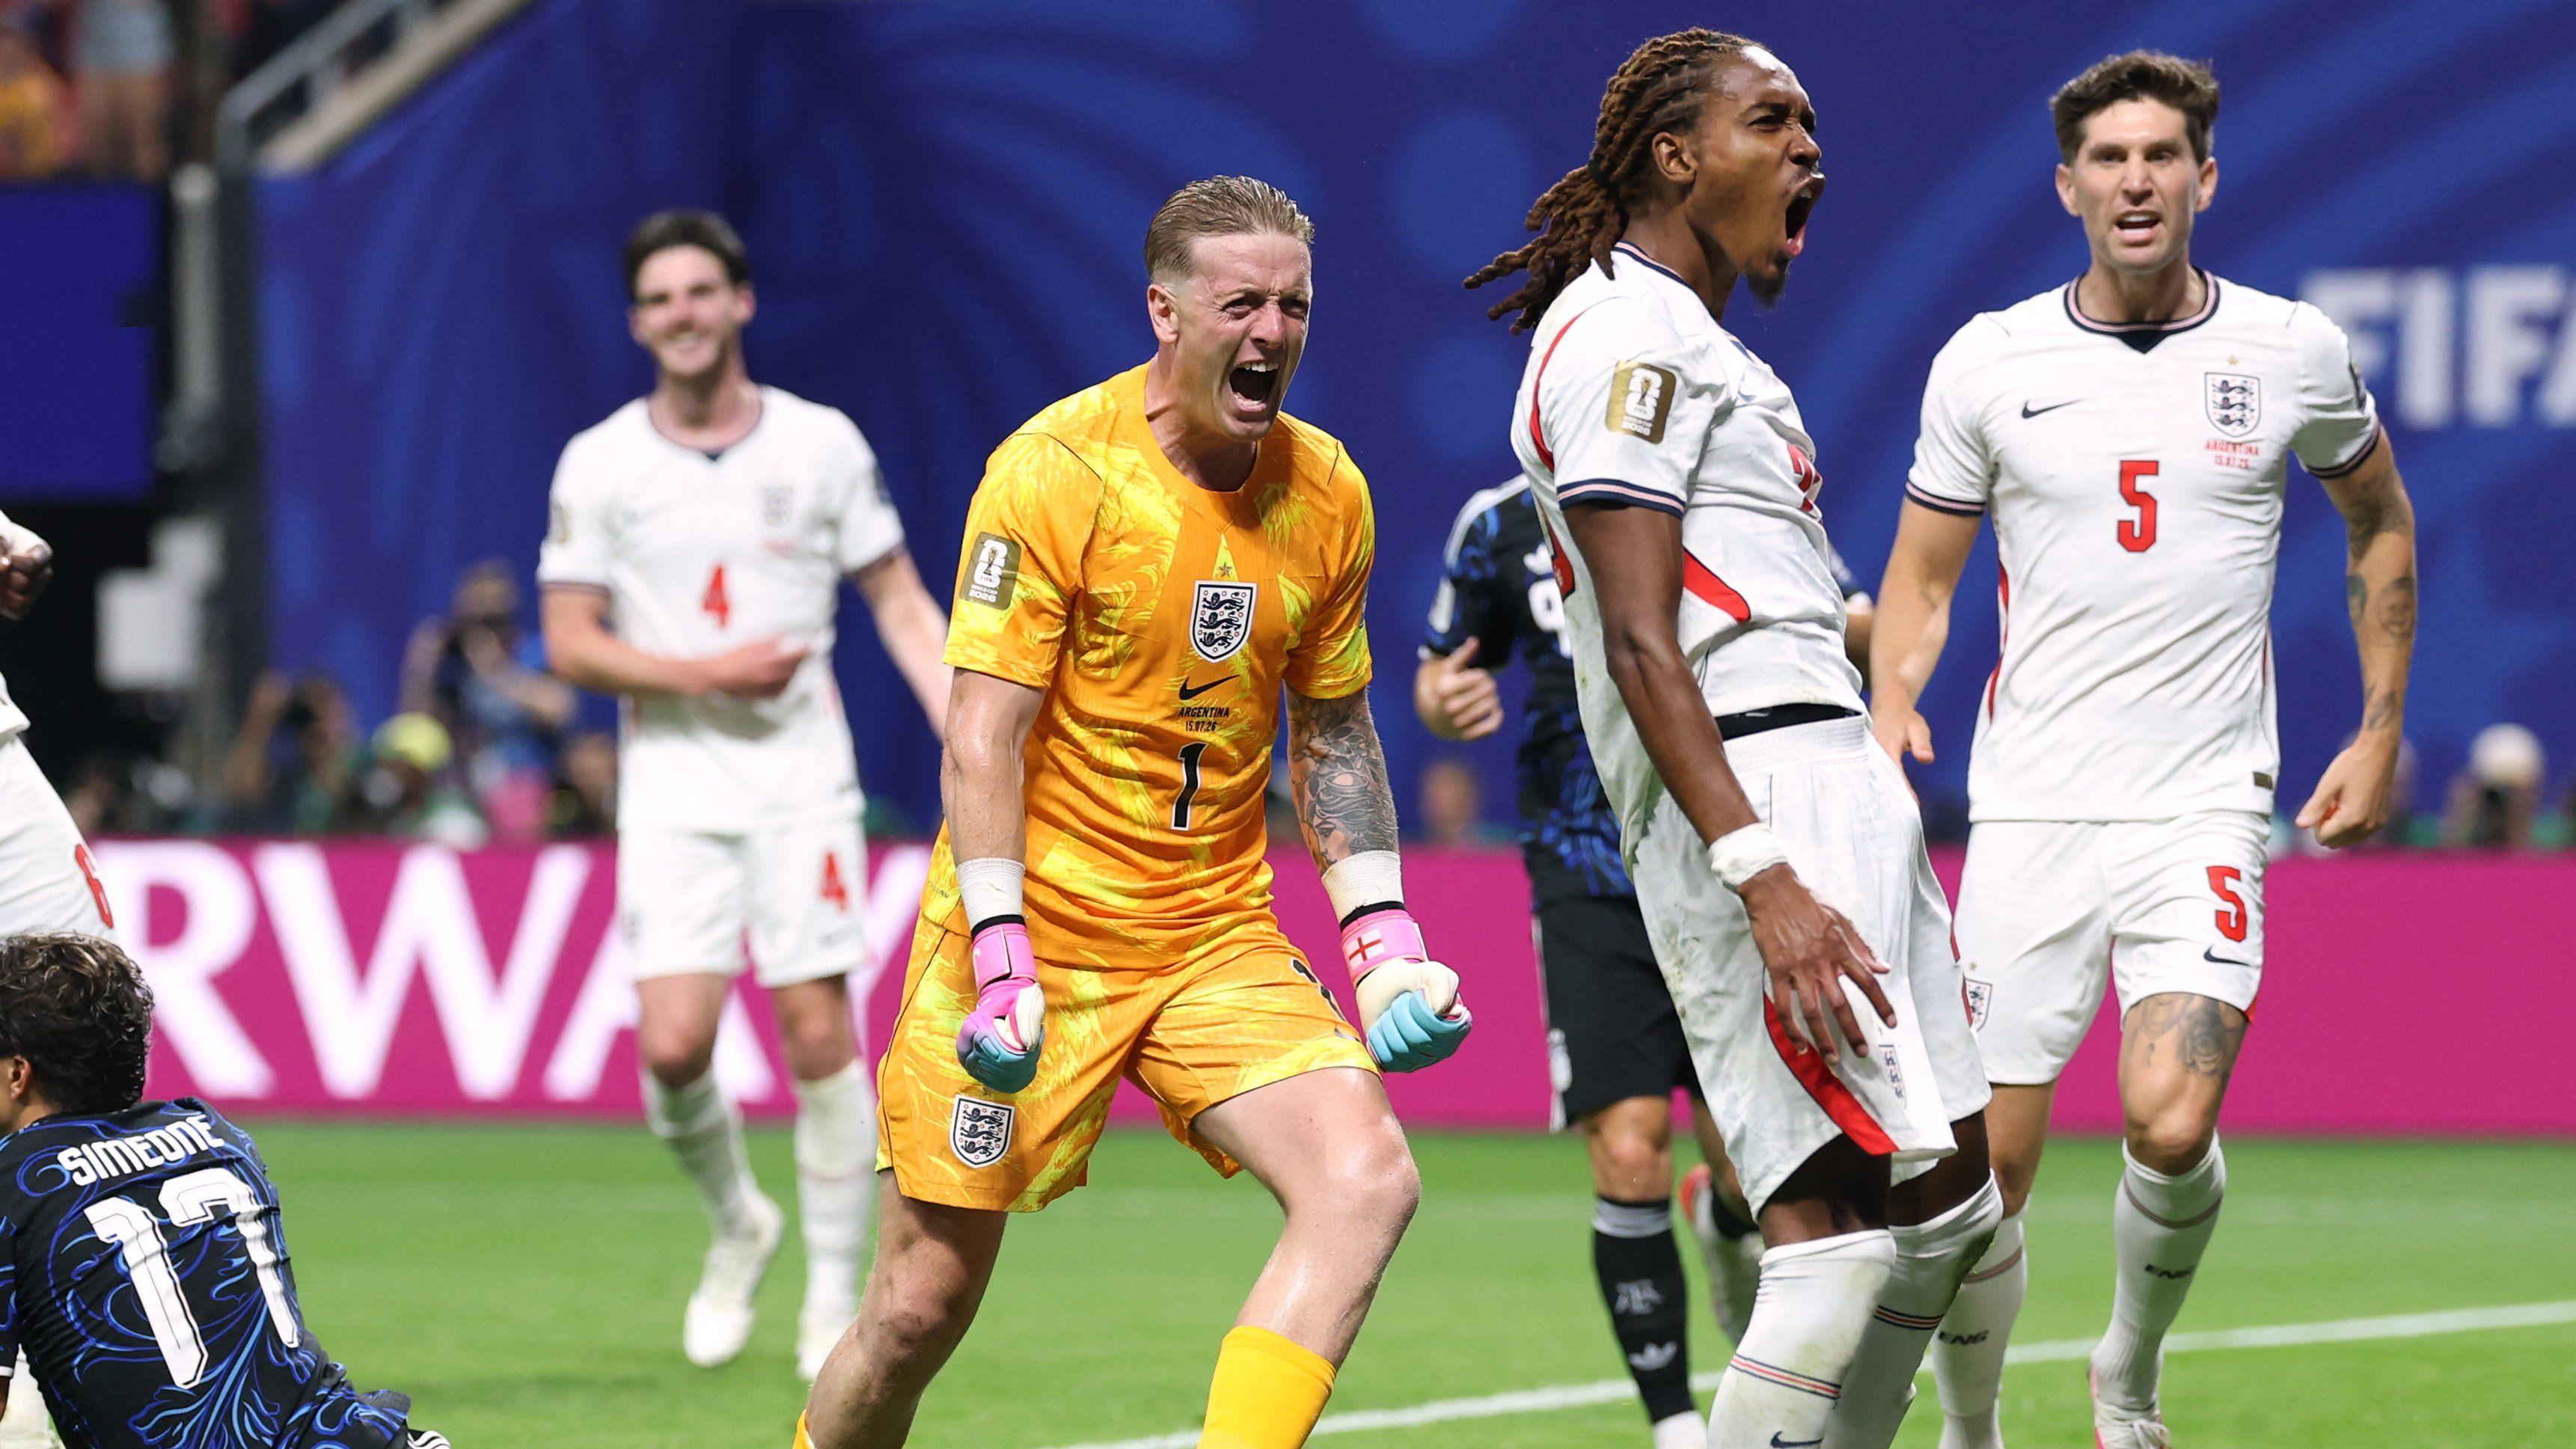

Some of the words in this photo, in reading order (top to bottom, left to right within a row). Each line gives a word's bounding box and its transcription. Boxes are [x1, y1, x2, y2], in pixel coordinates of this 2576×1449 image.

[2204, 440, 2259, 456] ARGENTINA
[2117, 459, 2159, 554] 5
[702, 563, 730, 629] 4
[968, 589, 997, 603] 2026
[1178, 706, 1230, 718] ARGENTINA
[1185, 720, 1217, 732] 15.07.26
[1170, 741, 1209, 831] 1
[74, 843, 114, 929] 6
[820, 848, 851, 914] 4
[2206, 866, 2247, 943] 5
[58, 1115, 224, 1186] SIMEONE
[83, 1167, 300, 1389] 17
